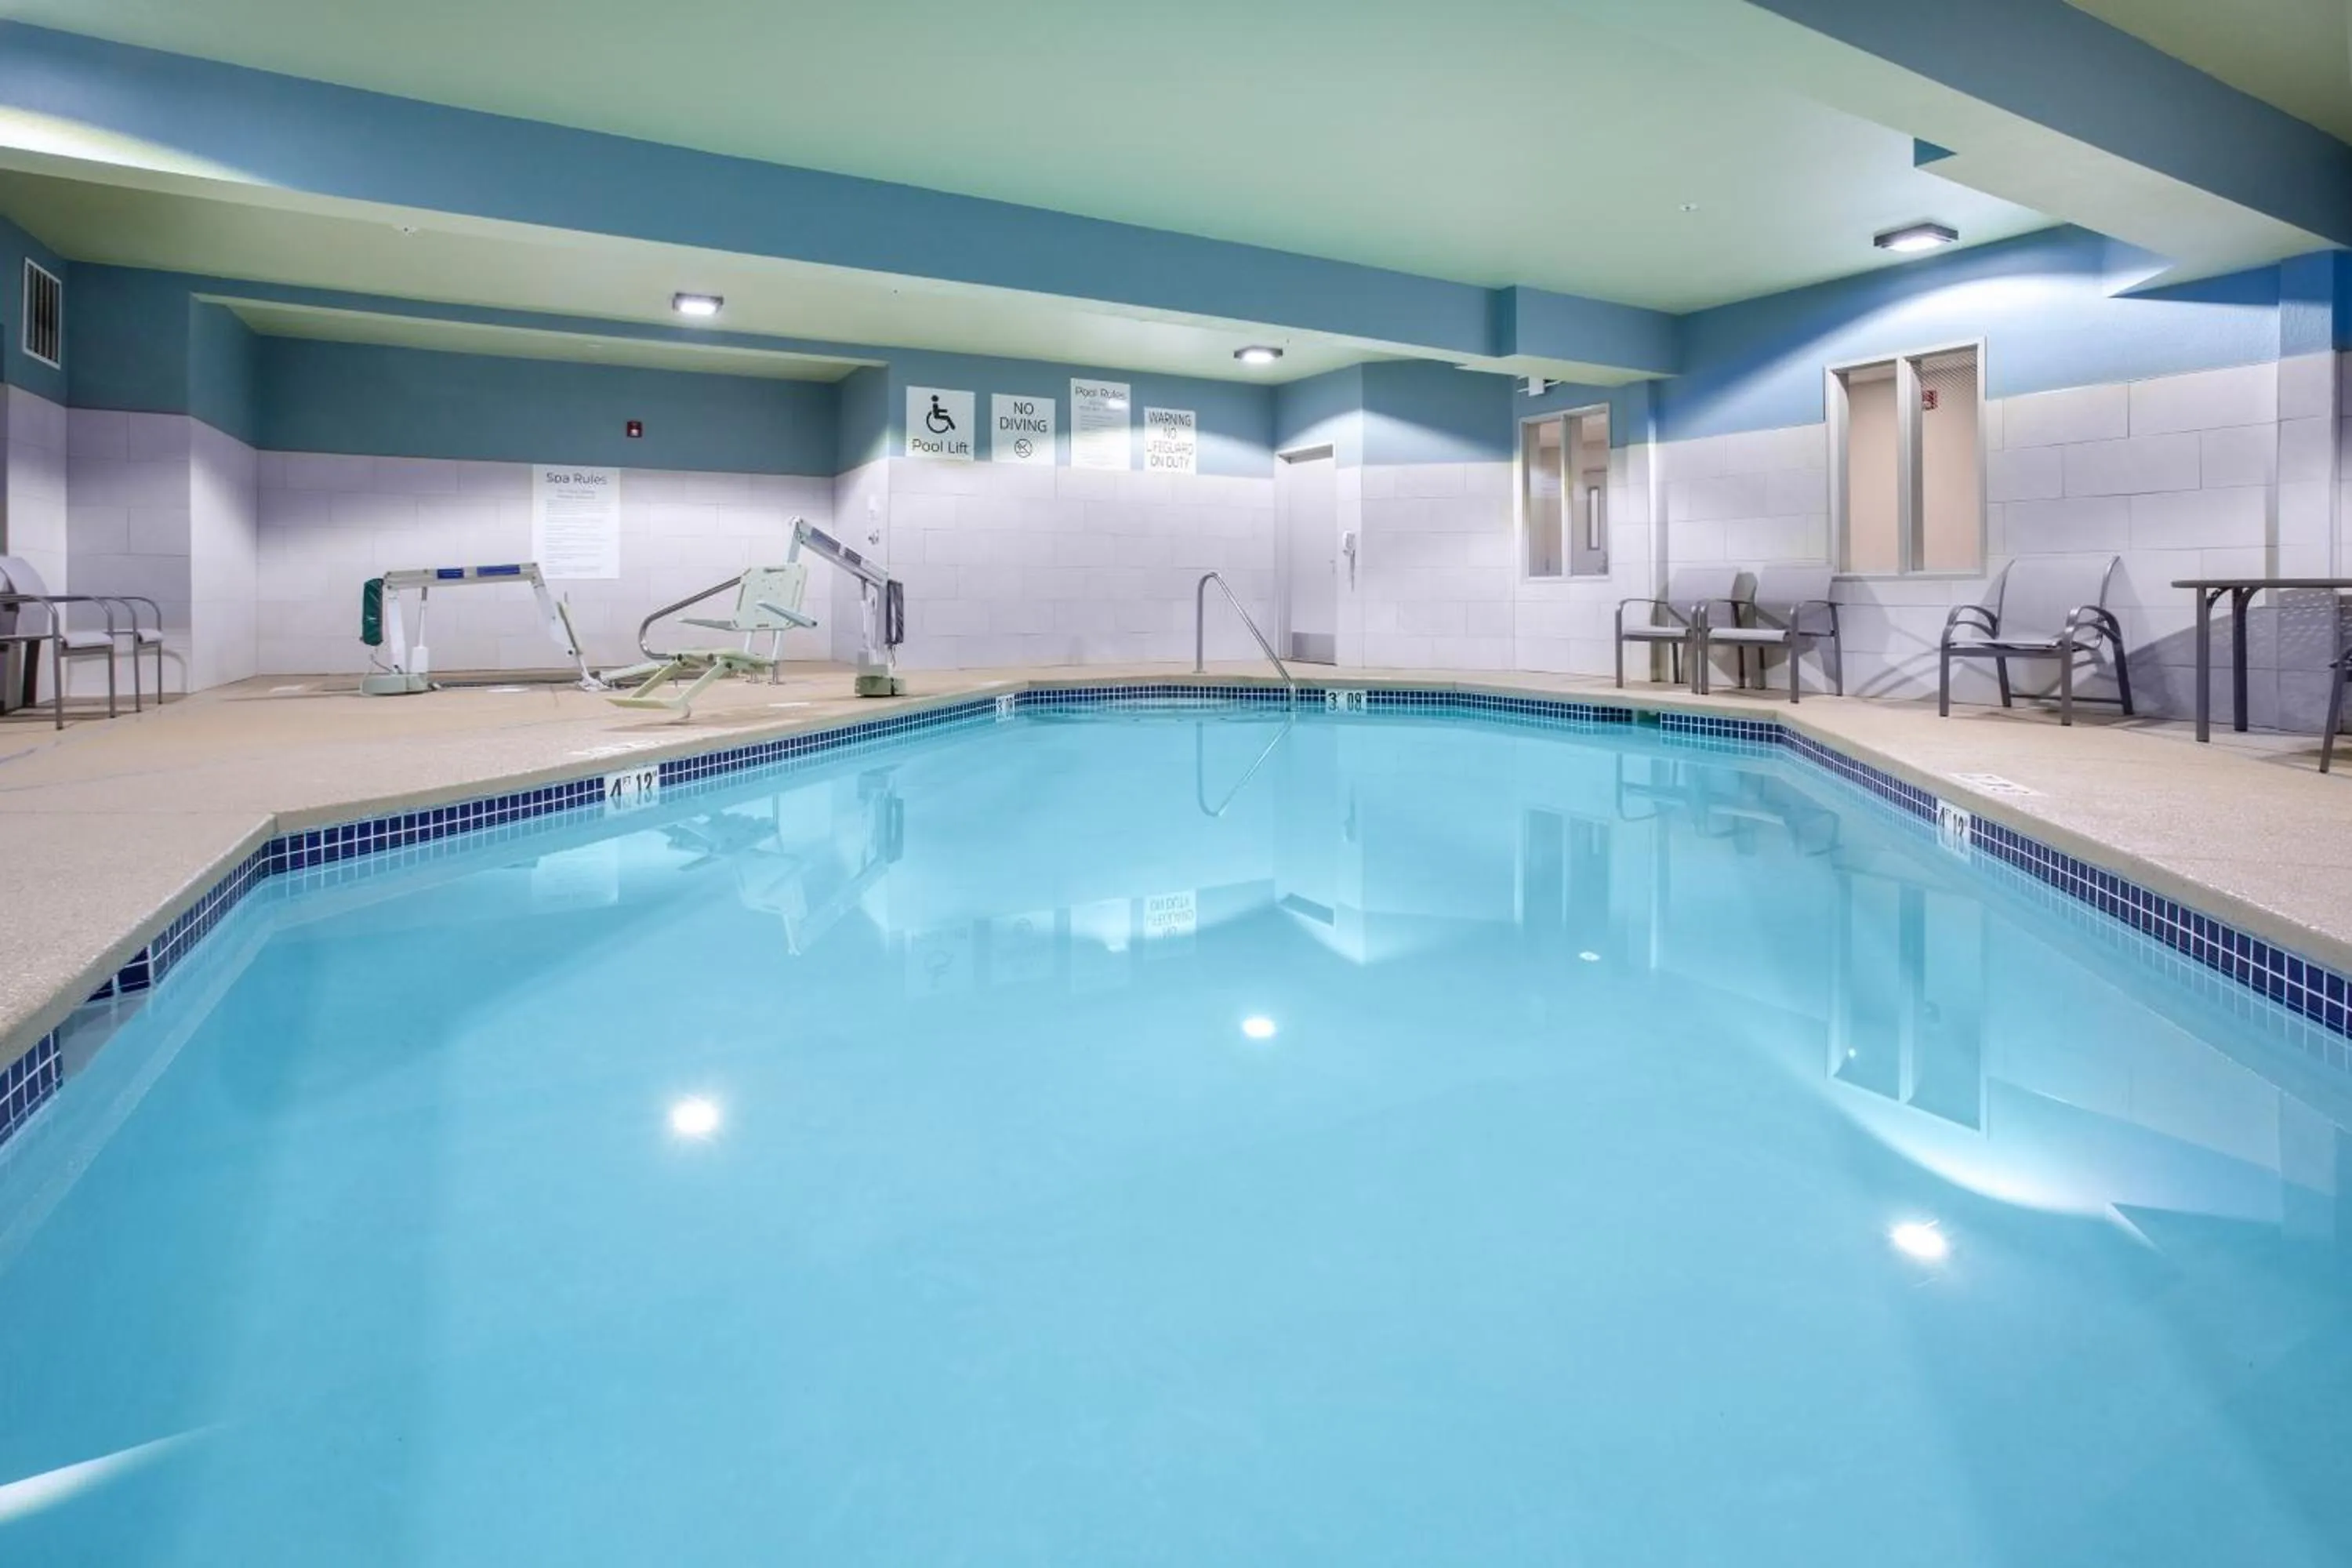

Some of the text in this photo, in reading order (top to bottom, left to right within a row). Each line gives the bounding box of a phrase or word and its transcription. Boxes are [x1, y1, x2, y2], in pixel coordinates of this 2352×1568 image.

[1014, 401, 1034, 415] NO
[1000, 416, 1047, 433] DIVING
[1149, 412, 1192, 426] WARNING
[1163, 426, 1177, 439] NO
[912, 438, 969, 455] Pool Lift
[1151, 455, 1189, 469] ON DUTY
[546, 472, 608, 485] Spa Rules
